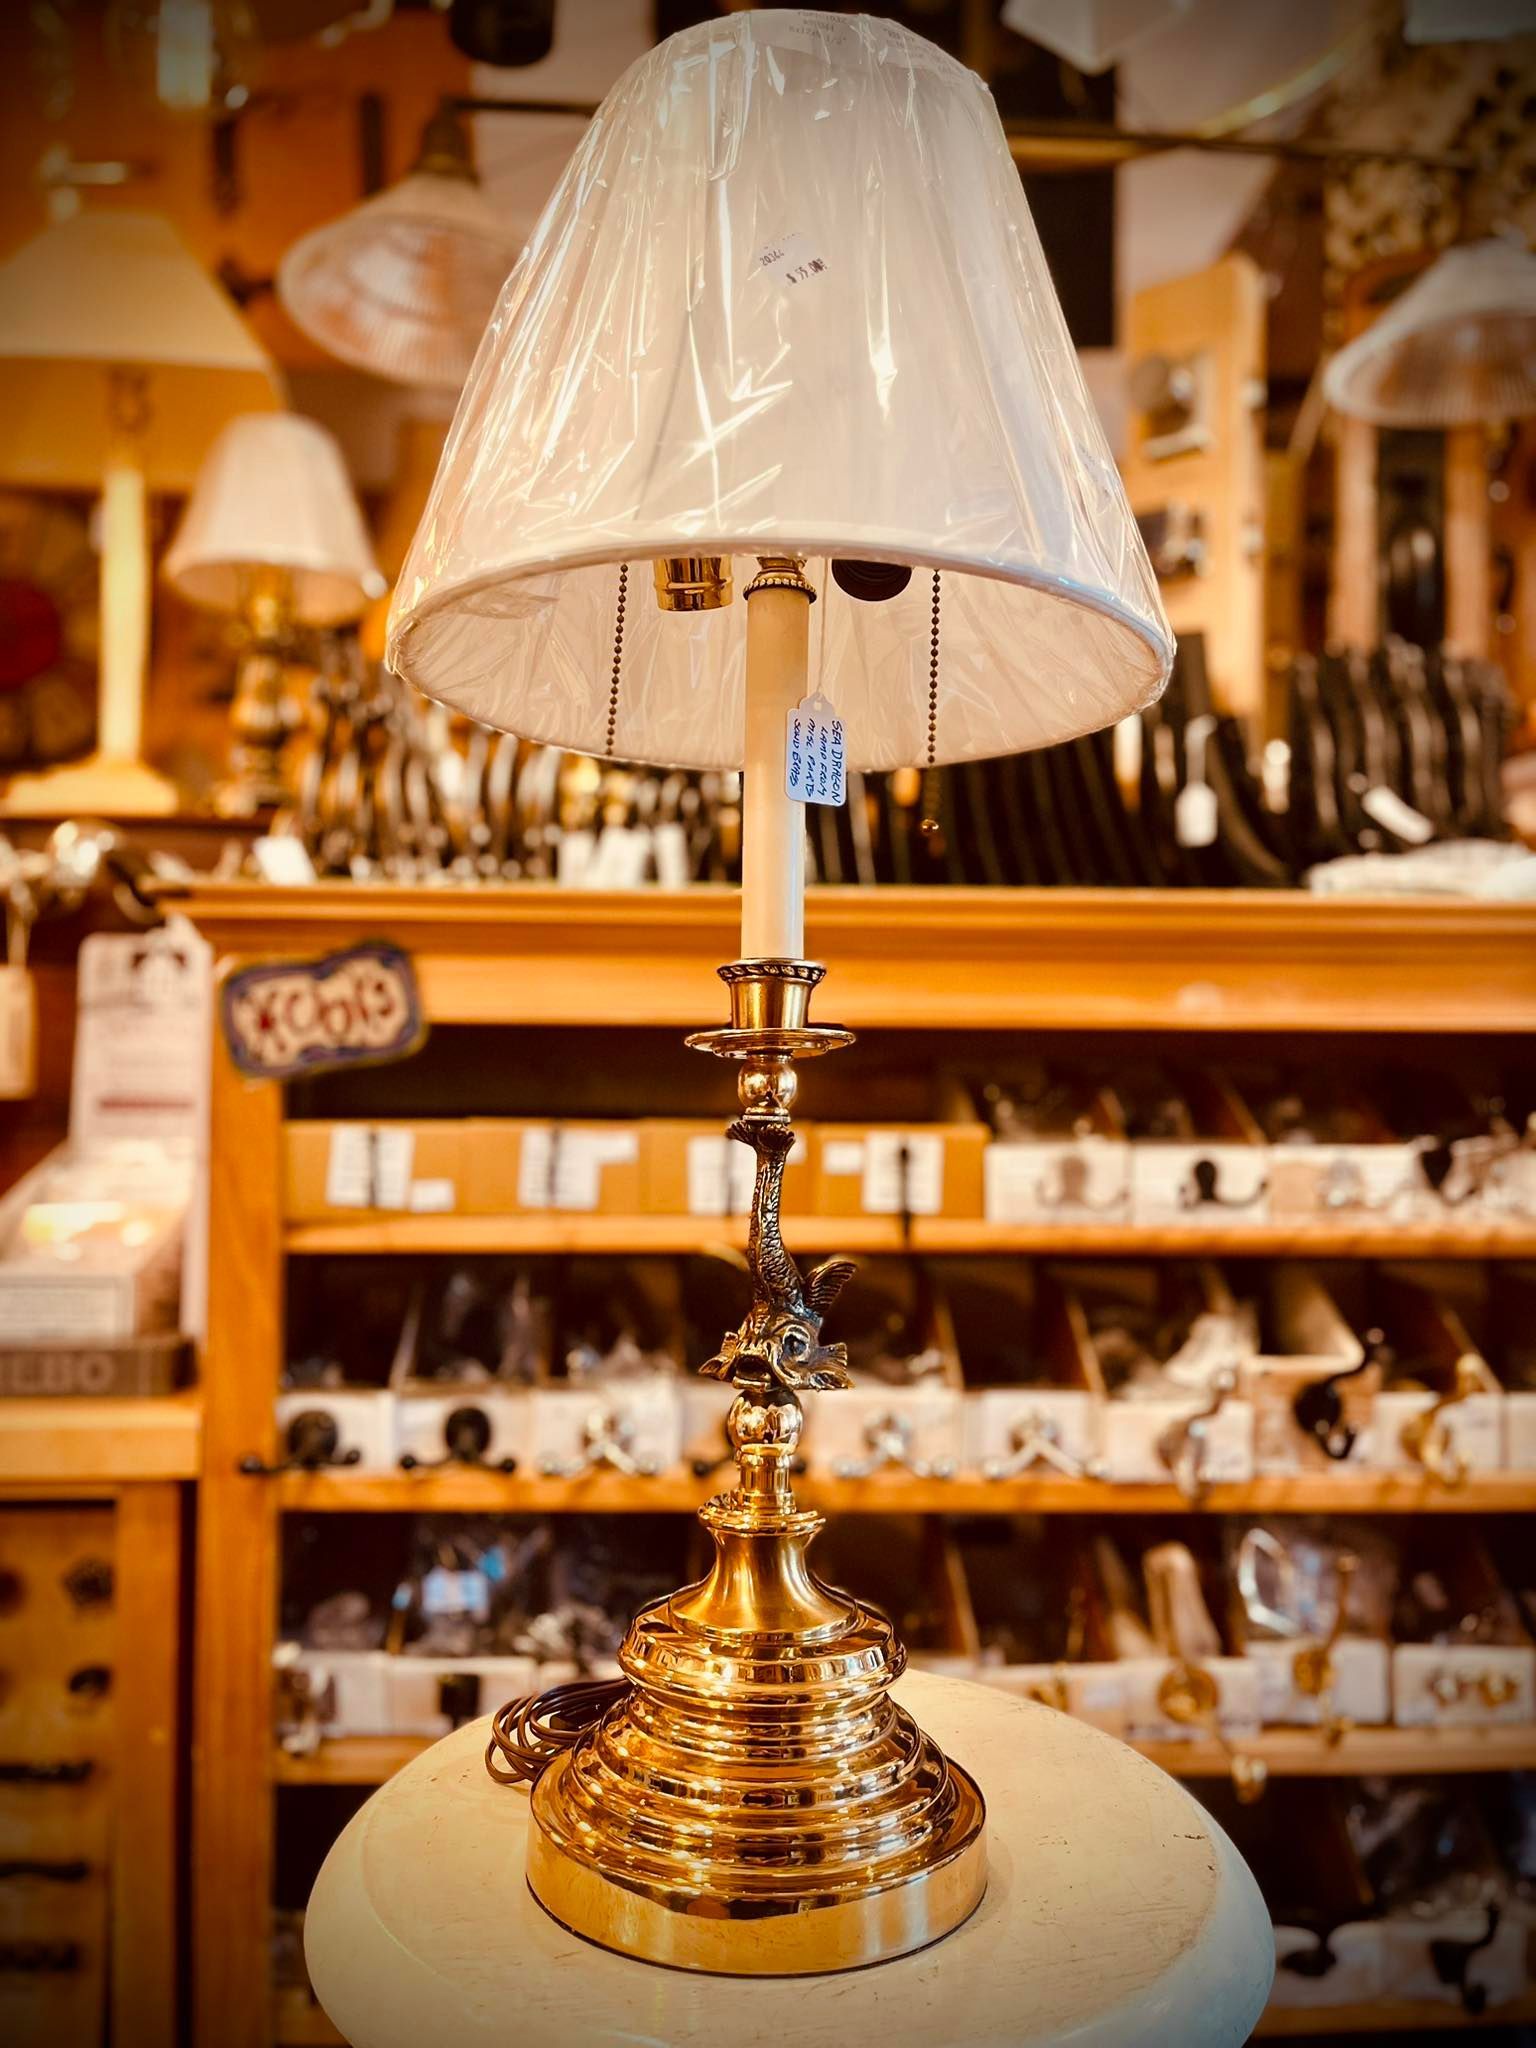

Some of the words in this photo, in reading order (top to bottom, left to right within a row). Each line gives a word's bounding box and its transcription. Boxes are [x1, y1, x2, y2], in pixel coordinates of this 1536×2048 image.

[819, 726, 828, 760] LAMP
[831, 720, 843, 745] SEA
[804, 755, 816, 797] PARTS
[817, 763, 828, 796] FROM
[831, 749, 843, 804] DRAGON
